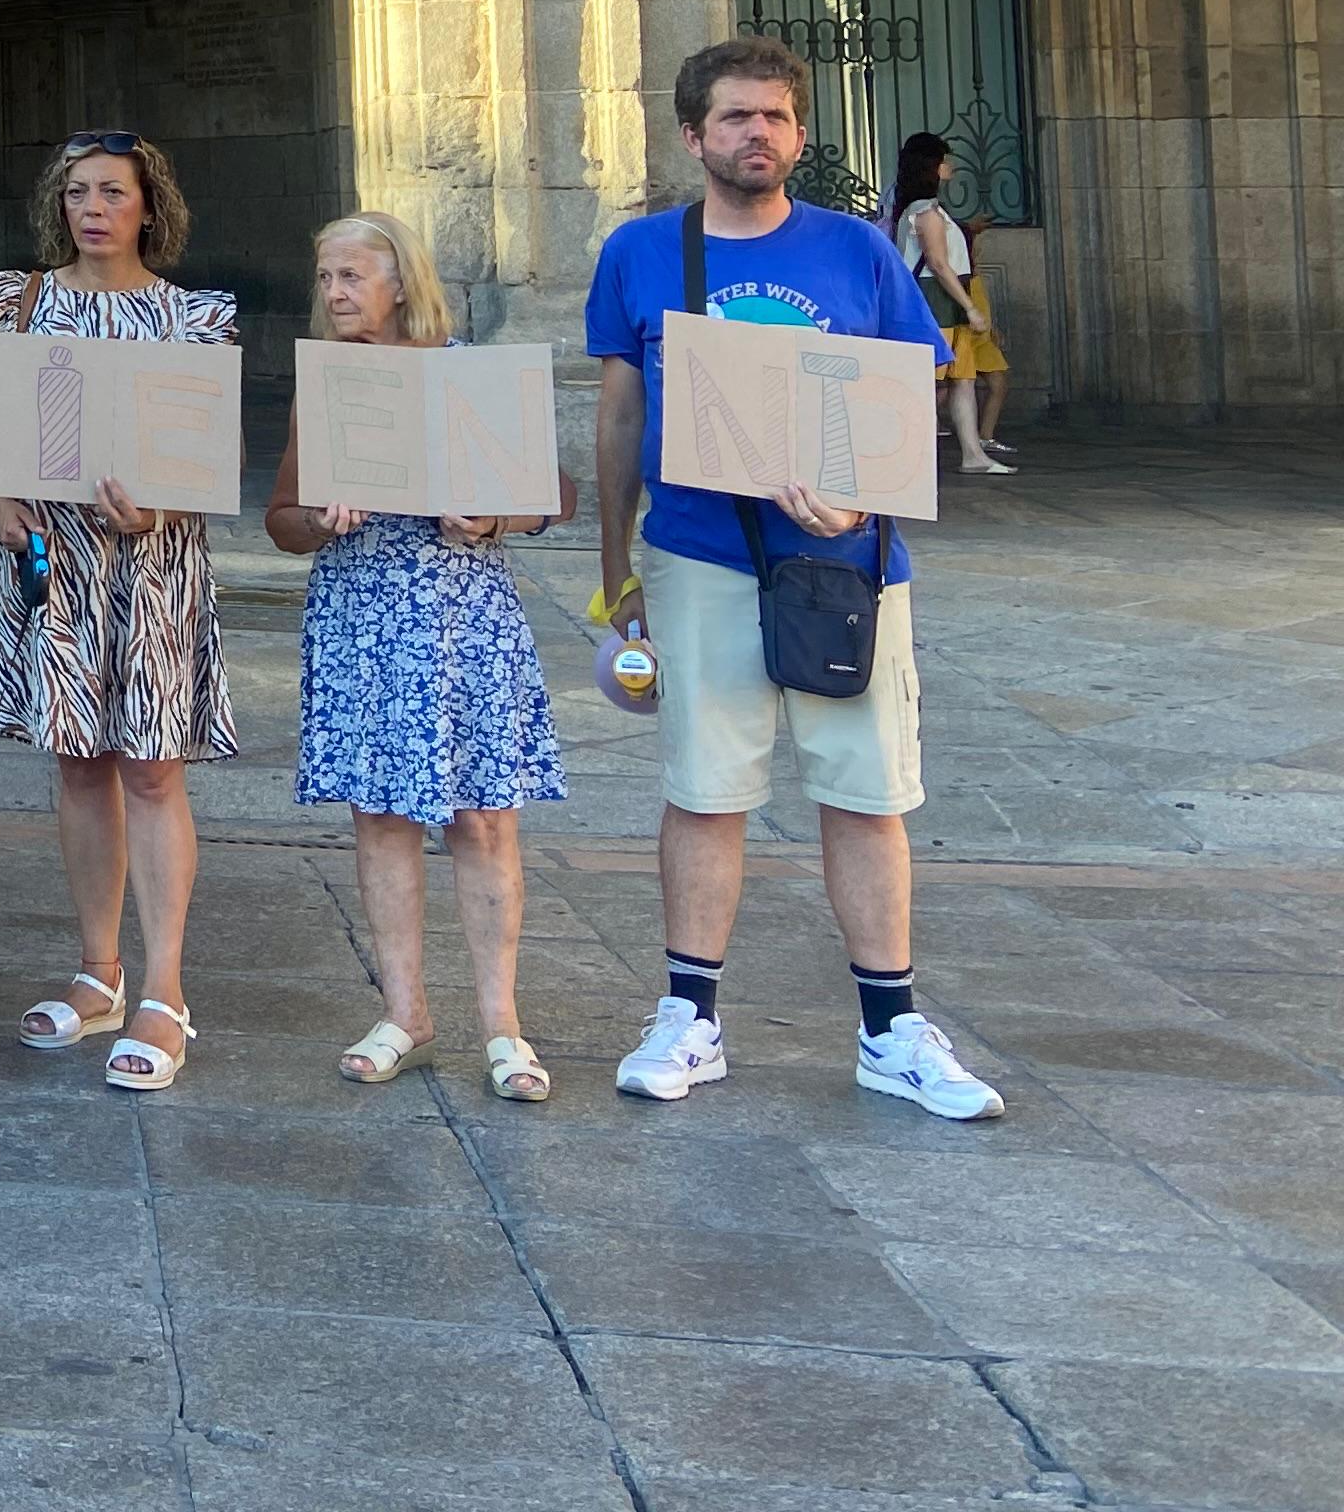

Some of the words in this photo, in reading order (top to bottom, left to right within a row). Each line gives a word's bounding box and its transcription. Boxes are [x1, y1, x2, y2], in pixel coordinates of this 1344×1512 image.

[706, 282, 759, 303] TTER
[765, 282, 820, 318] WITH
[816, 317, 832, 334] A
